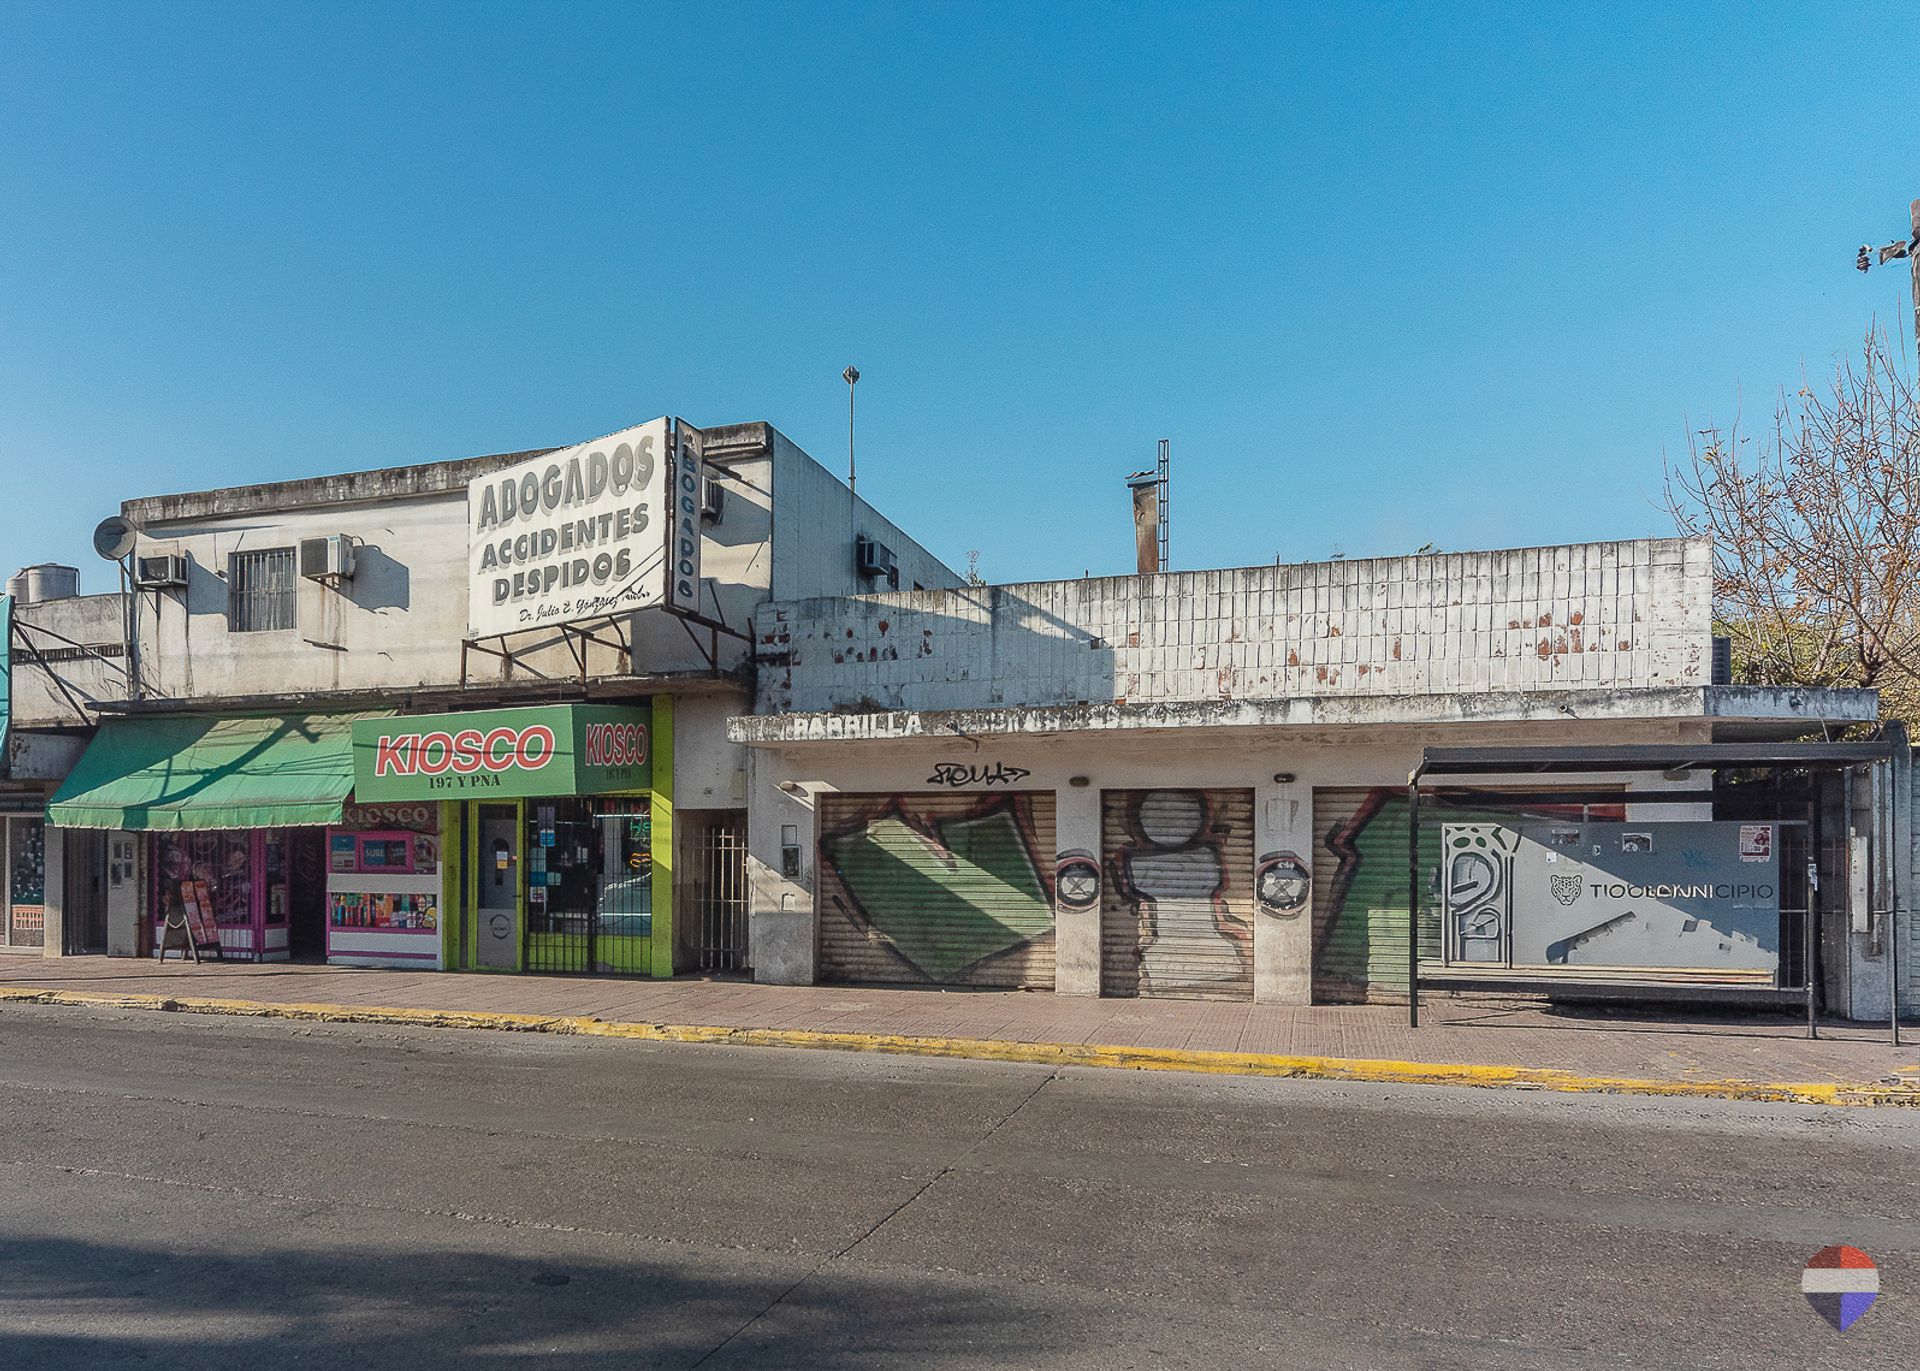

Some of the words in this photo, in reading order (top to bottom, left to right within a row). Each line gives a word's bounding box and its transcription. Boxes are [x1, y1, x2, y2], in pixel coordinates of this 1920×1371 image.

[478, 503, 649, 574] ACCIDENTES
[493, 548, 631, 606] DESPIDOS
[519, 608, 534, 622] Dr.
[536, 603, 560, 622] Julio
[375, 724, 556, 777] KIOSCO
[585, 723, 648, 766] KIOSCO
[429, 776, 453, 790] 197
[457, 775, 467, 788] Y
[471, 773, 501, 788] PNA
